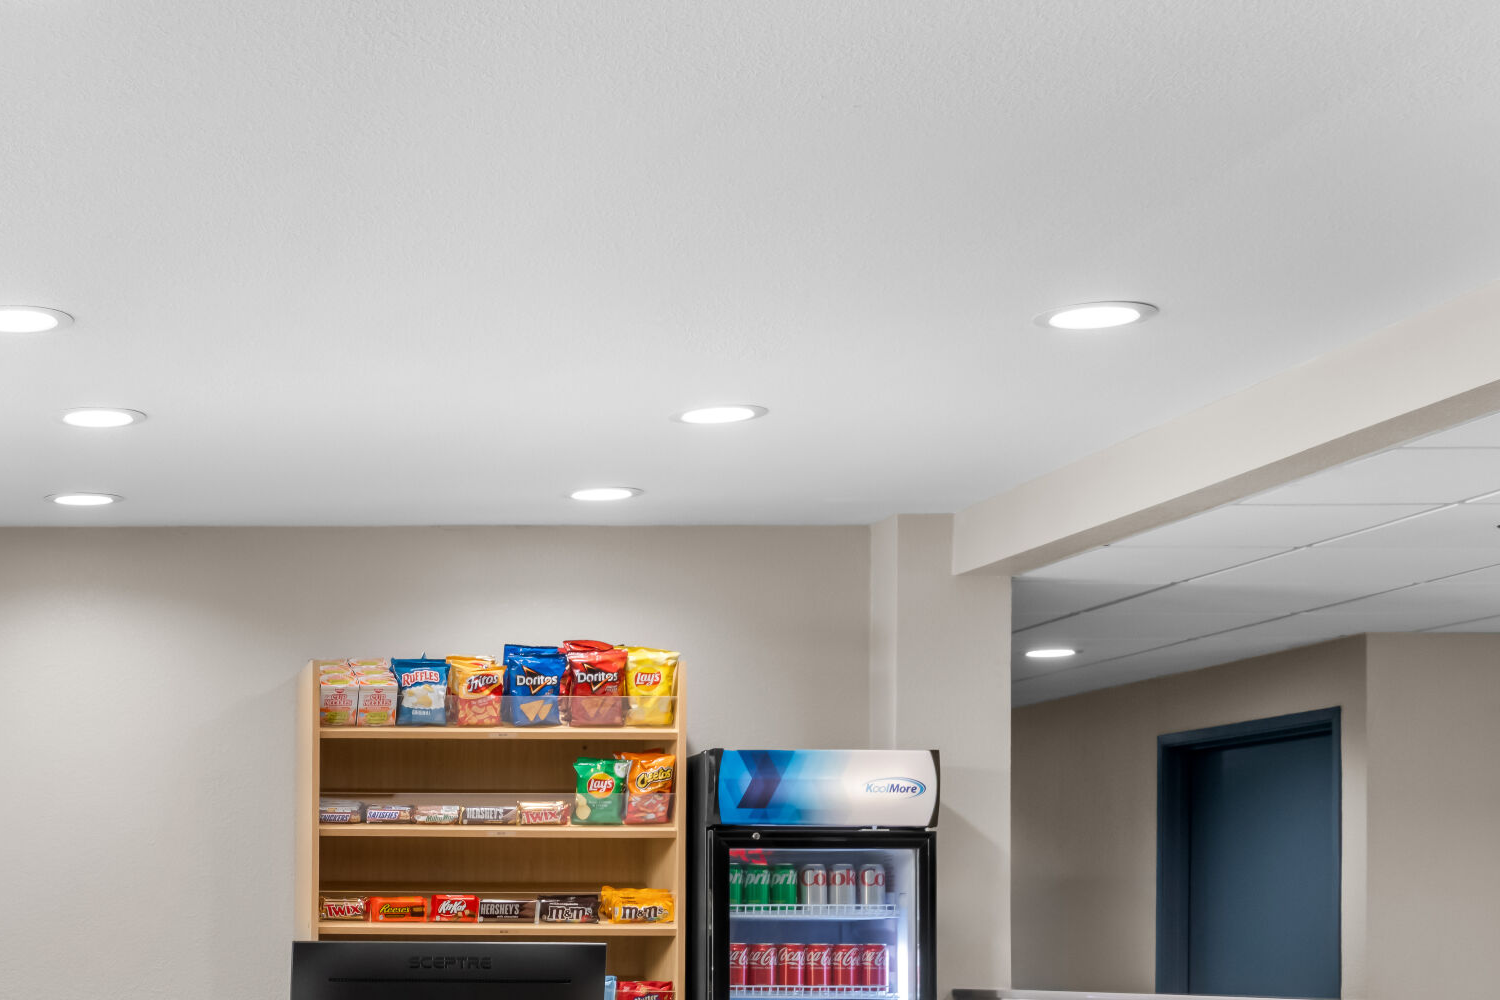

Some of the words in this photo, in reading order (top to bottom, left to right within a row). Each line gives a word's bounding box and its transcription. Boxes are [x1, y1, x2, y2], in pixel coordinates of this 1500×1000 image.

[402, 670, 439, 687] RUFFLES
[467, 674, 499, 692] Fritos
[516, 674, 558, 686] Doritos
[576, 671, 618, 683] Doritos
[635, 672, 661, 686] Lay's
[637, 767, 672, 789] Cheetos
[589, 778, 613, 792] Lay's
[865, 784, 918, 793] KoolMore
[367, 810, 399, 820] SATISFIES
[466, 807, 504, 820] HERSHEY'S
[480, 903, 520, 916] HERSHEY'S
[409, 955, 492, 970] SCEPTRE
